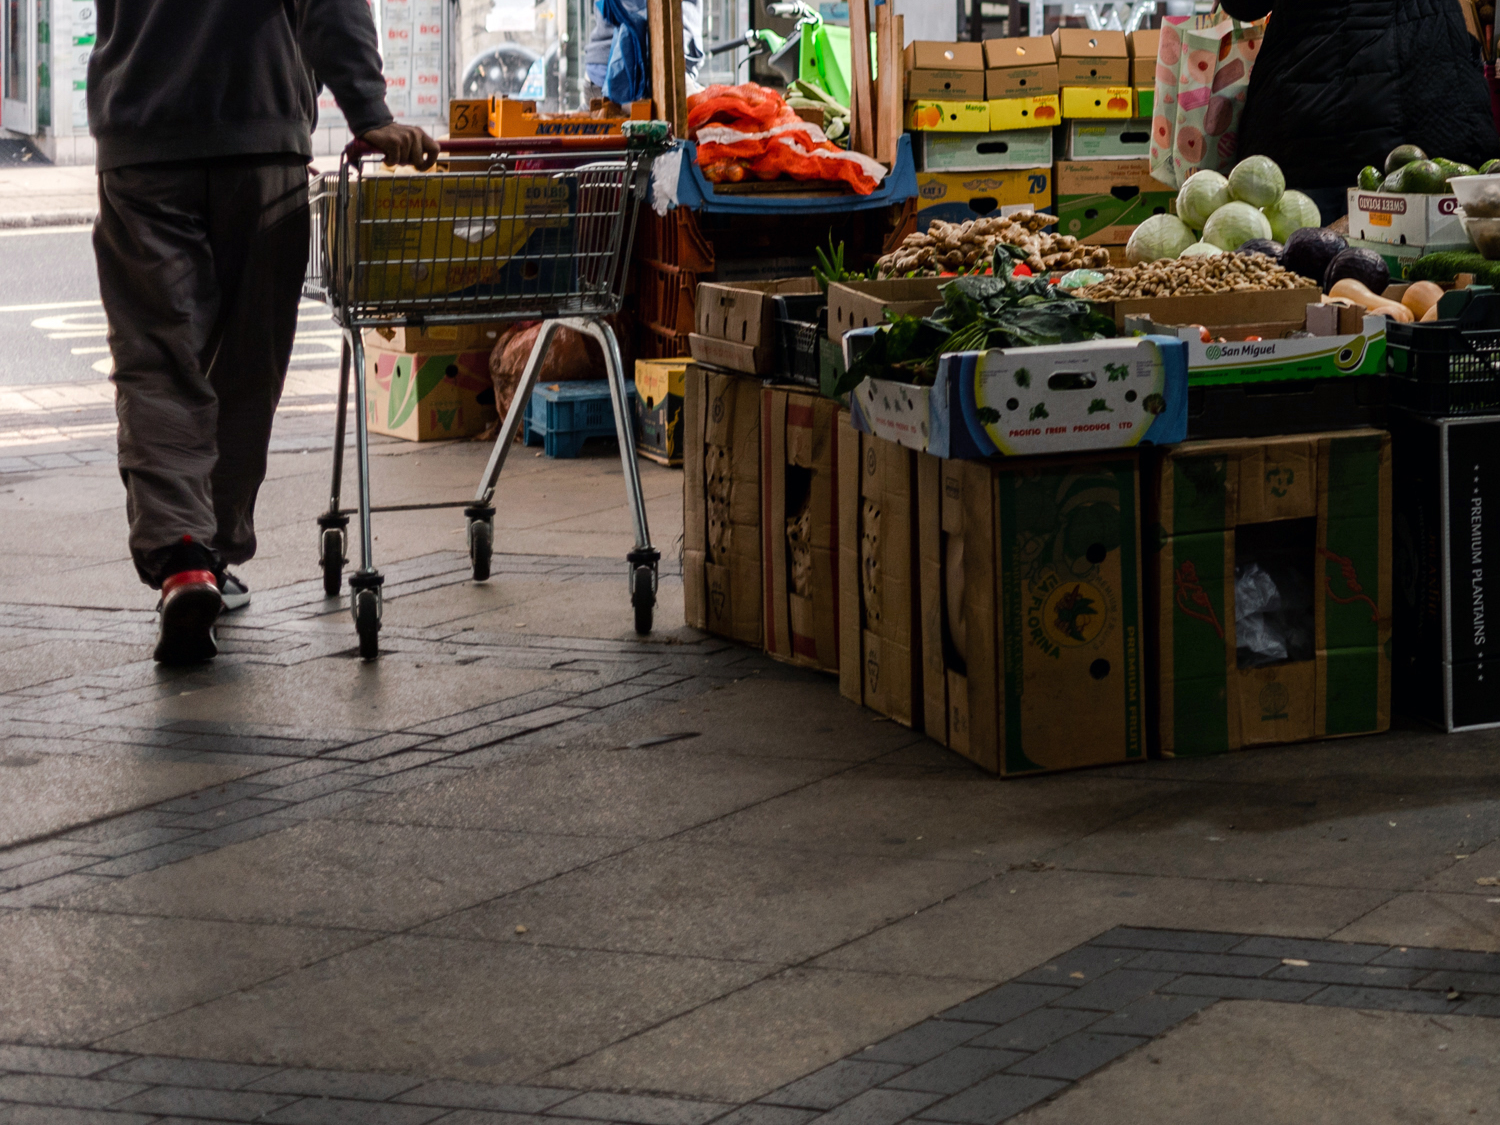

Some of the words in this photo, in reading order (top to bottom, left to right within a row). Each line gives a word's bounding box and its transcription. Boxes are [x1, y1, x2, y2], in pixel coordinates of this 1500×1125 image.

[454, 104, 470, 131] 3
[965, 103, 987, 113] Mango
[537, 123, 615, 136] NOVOFRUT
[922, 186, 937, 195] CAT
[1027, 174, 1047, 195] 79
[1381, 200, 1405, 213] SWEET
[1220, 345, 1240, 358] San
[1242, 343, 1276, 358] Miguel
[1008, 426, 1042, 438] PACIFIC
[1044, 424, 1068, 436] FRESH
[1072, 422, 1114, 435] PRODUCE
[1118, 421, 1134, 431] LTD
[1470, 497, 1483, 568] PREMIUM
[1472, 570, 1486, 646] PLANTAINS
[1027, 594, 1060, 660] FLORINA
[1126, 625, 1140, 698] PREMIUM
[1128, 699, 1141, 751] FRUIT
